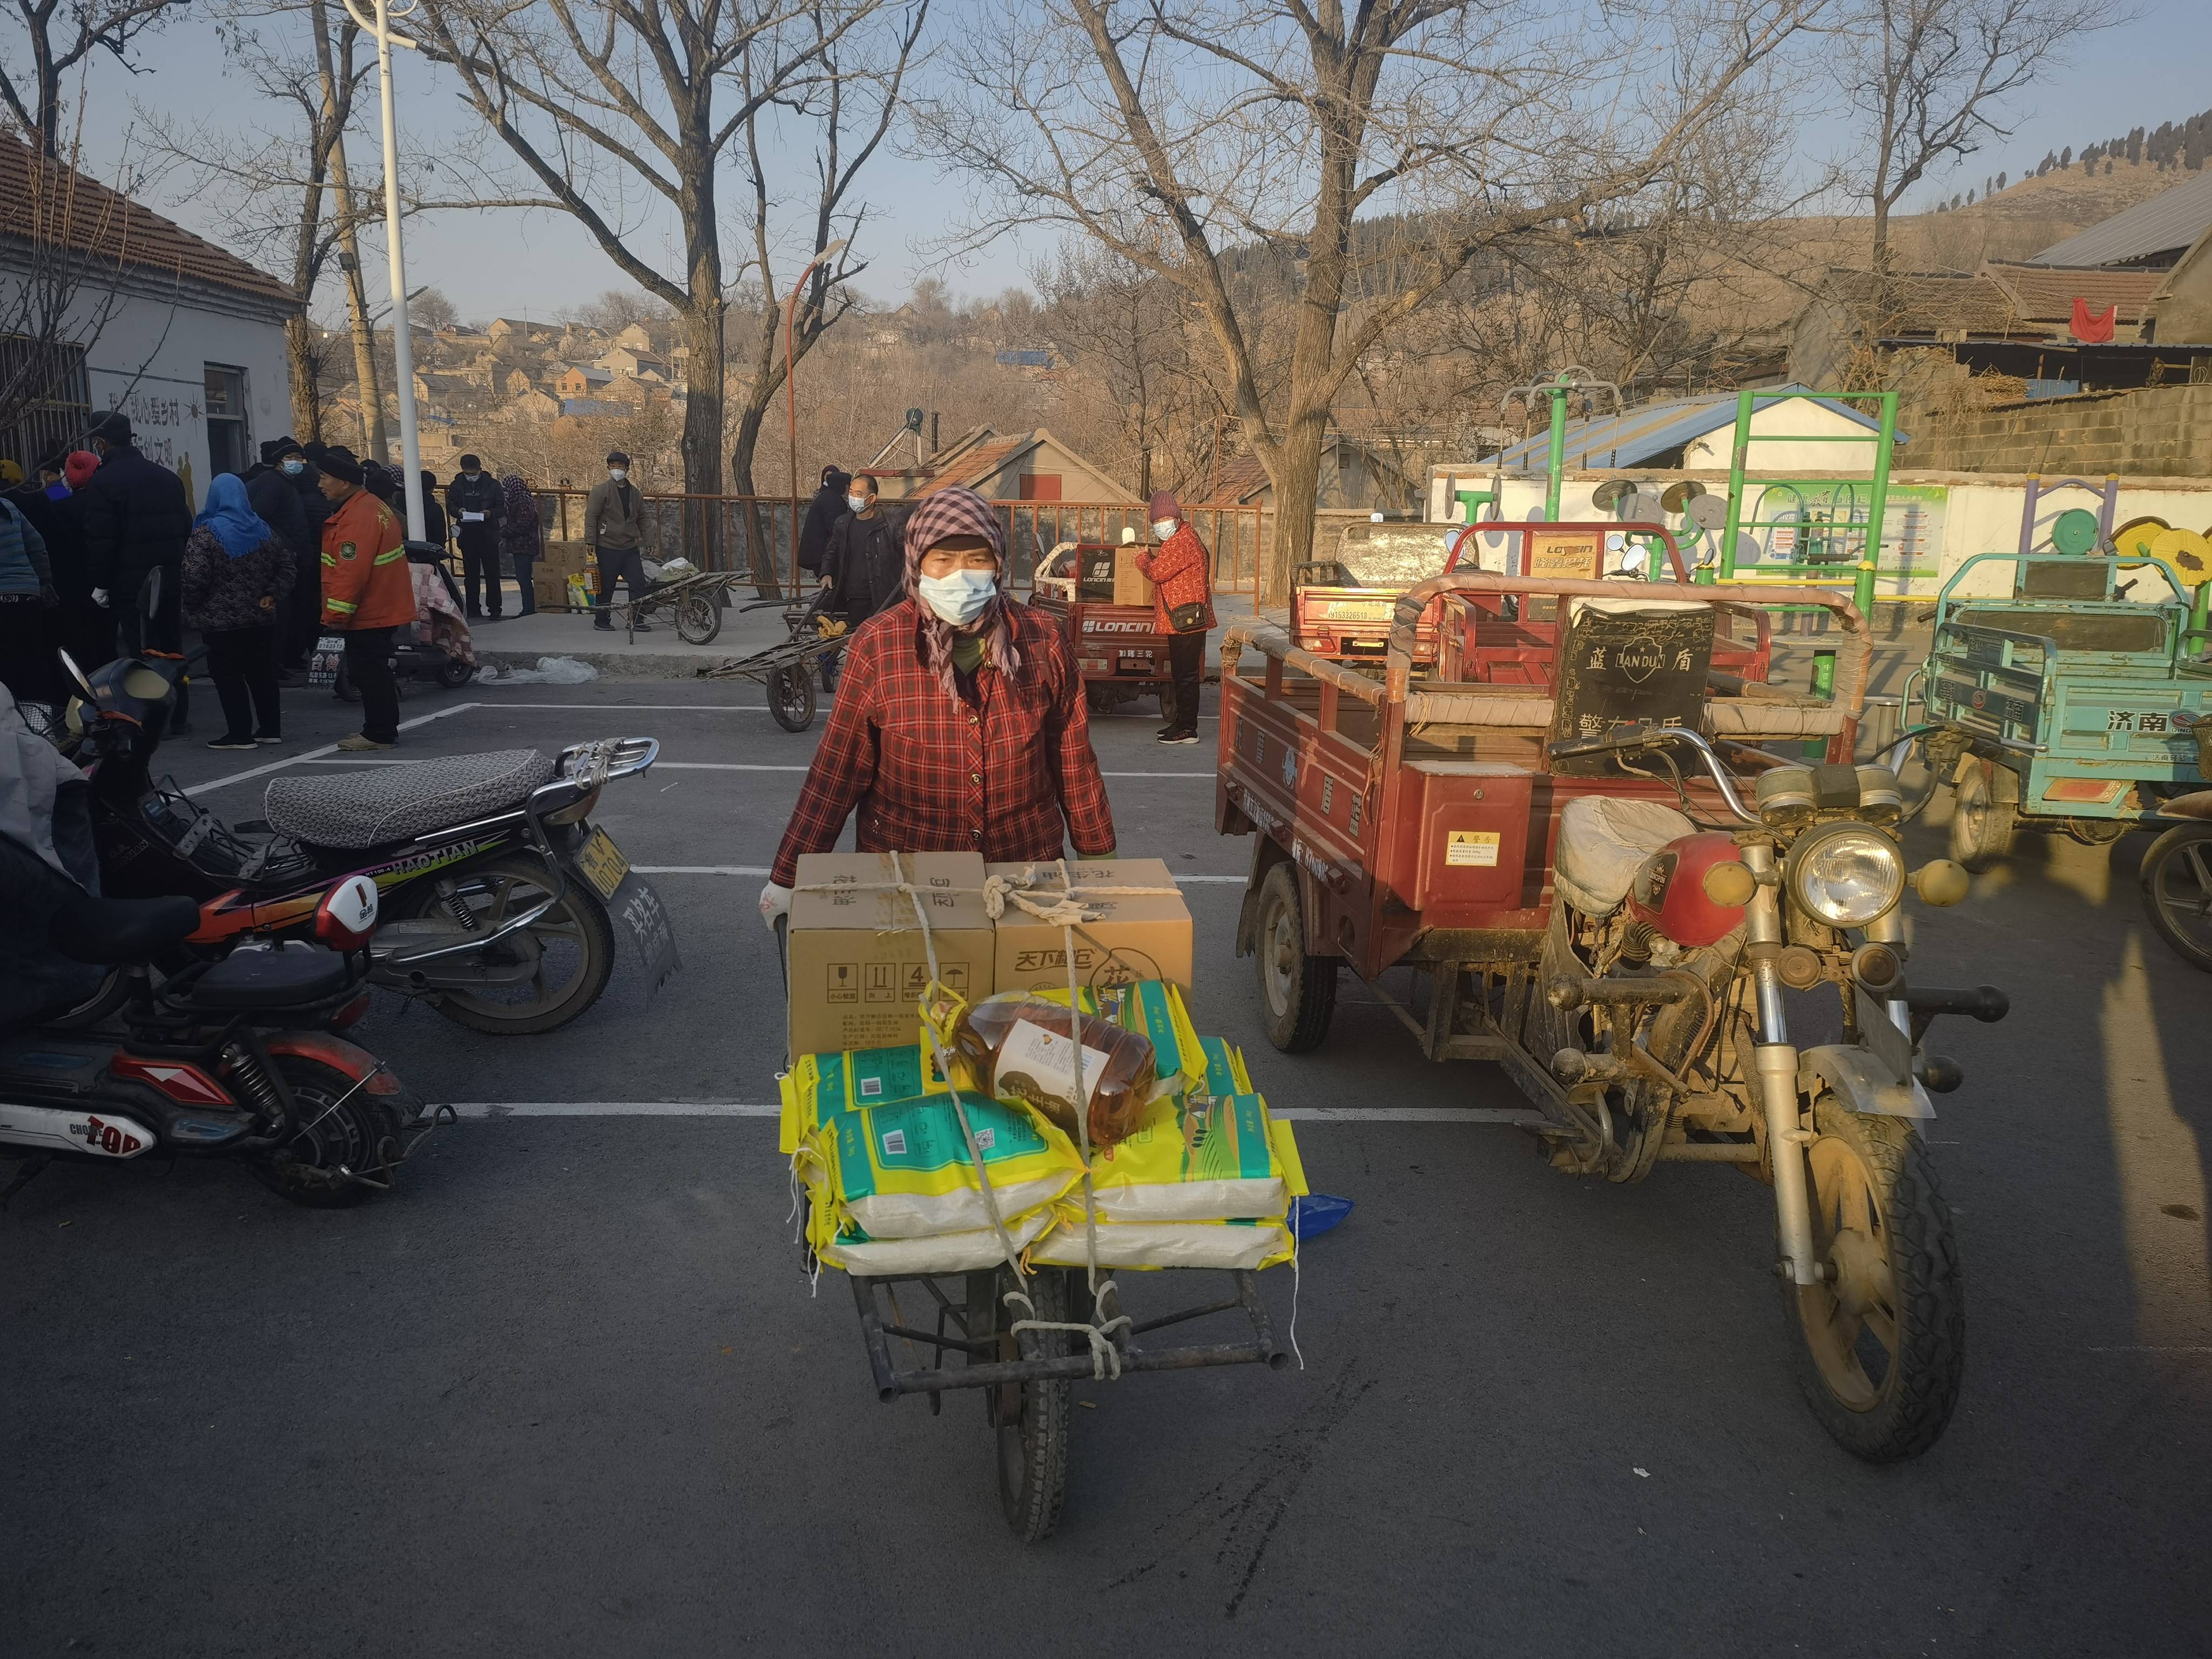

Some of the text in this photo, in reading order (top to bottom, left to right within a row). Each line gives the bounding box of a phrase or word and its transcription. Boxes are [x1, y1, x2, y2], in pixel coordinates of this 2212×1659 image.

[1547, 545, 1593, 554] LOIN
[1534, 556, 1592, 568] 隆鑫摩托
[1095, 622, 1151, 632] LONCIN
[1586, 646, 1607, 670] 蓝
[1671, 648, 1694, 671] 盾
[2107, 710, 2169, 732] 济南
[1473, 835, 1491, 844] 警告
[393, 840, 478, 874] HAOTIAN
[930, 876, 952, 909] 天下仓
